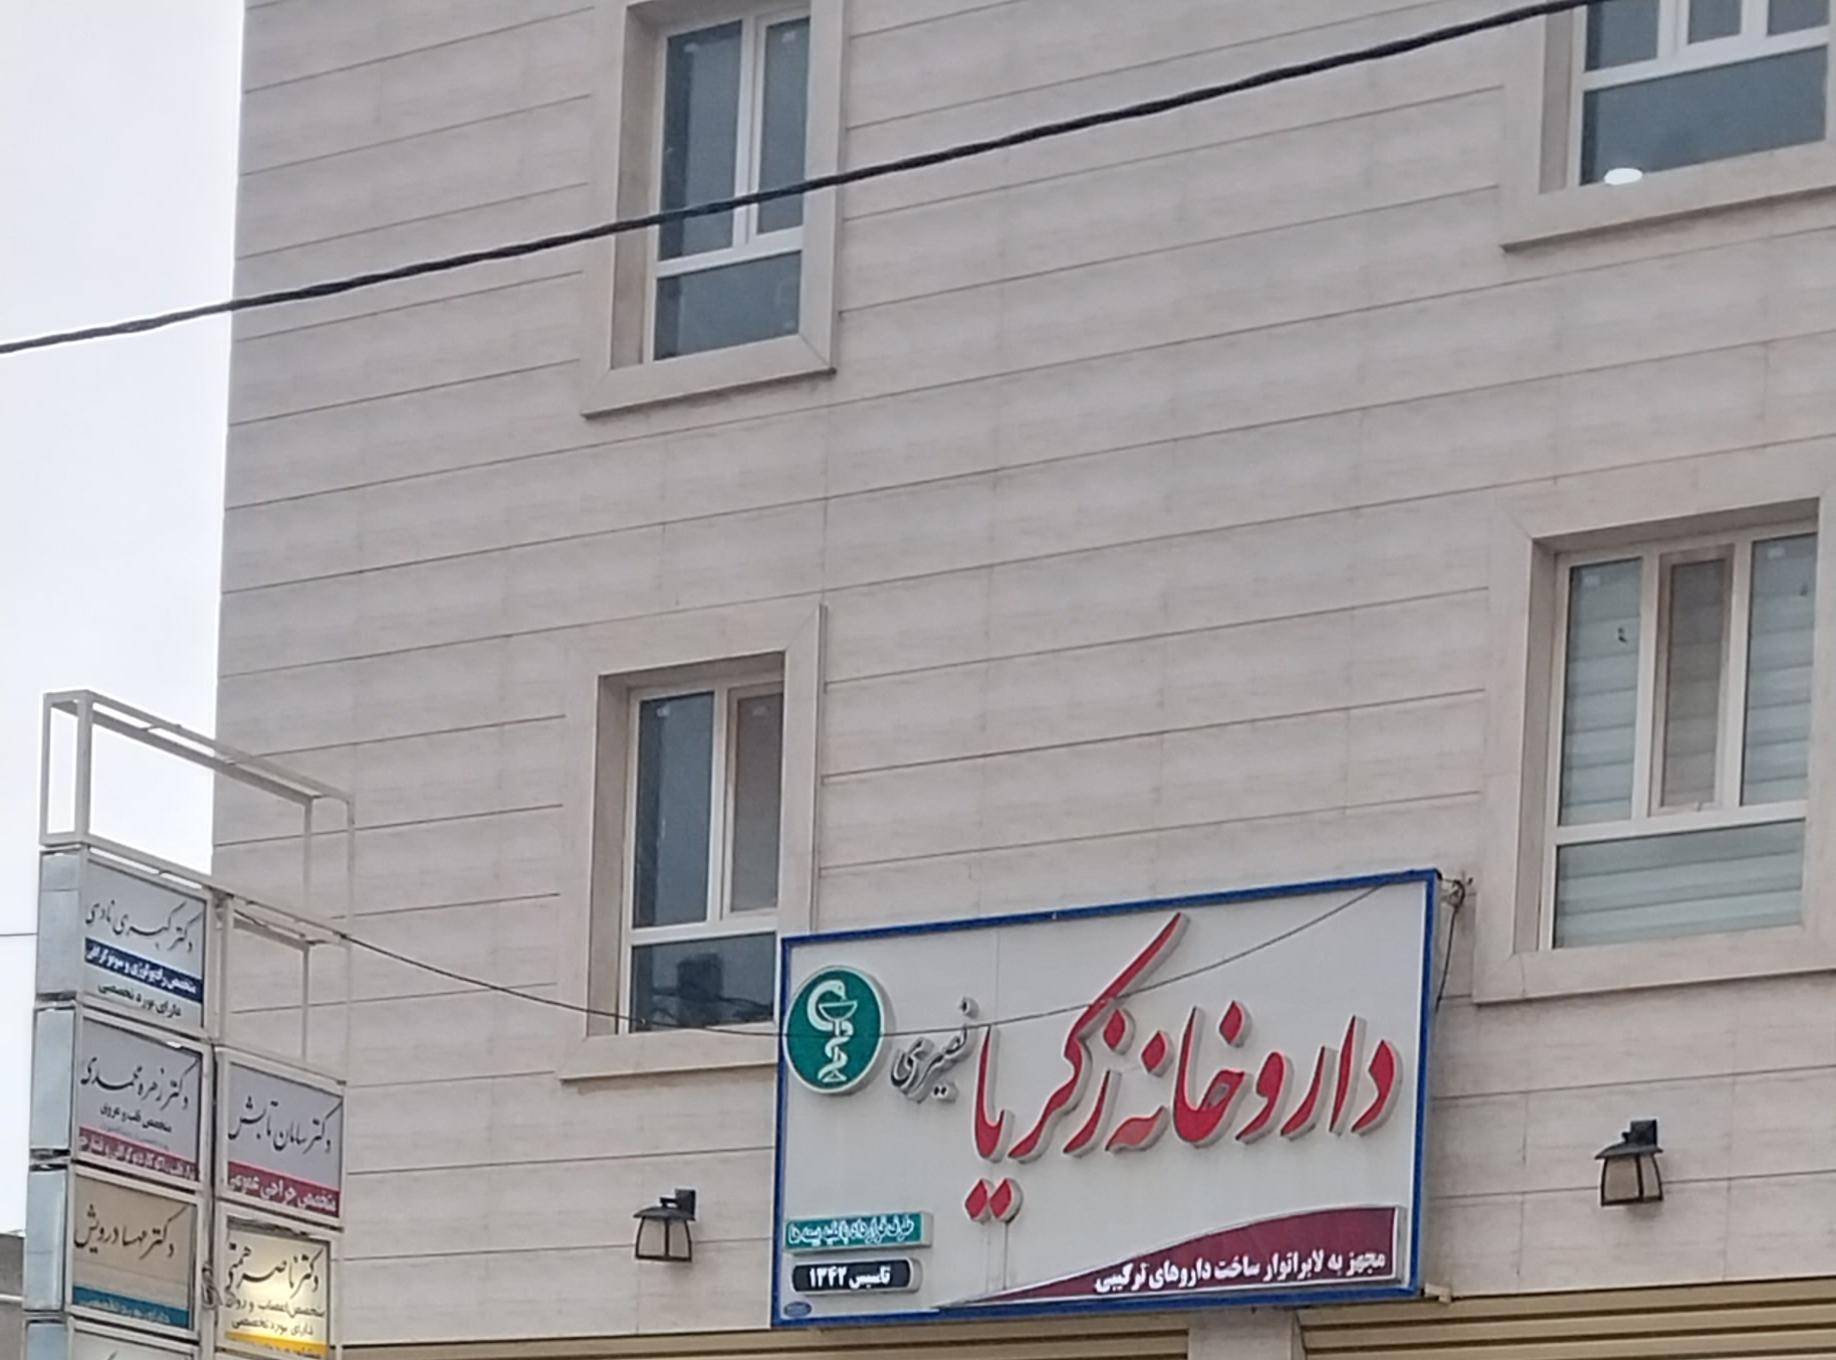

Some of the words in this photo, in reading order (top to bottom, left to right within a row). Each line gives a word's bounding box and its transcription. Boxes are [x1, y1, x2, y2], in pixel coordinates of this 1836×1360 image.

[167, 911, 203, 952] دکتر
[890, 996, 979, 1103] نصیری
[964, 911, 1190, 1223] زکریا
[80, 1056, 143, 1091] محمدی
[159, 1058, 198, 1111] دکتر
[1106, 999, 1399, 1154] داروخانه
[227, 1095, 279, 1140] تابش
[272, 1119, 307, 1151] سامان
[302, 1099, 342, 1154] دکتر
[73, 1203, 120, 1254] درویش
[139, 1203, 191, 1261] دکتر
[289, 1247, 324, 1300] دکتر
[849, 1264, 892, 1289] تاسیس
[1094, 1262, 1149, 1294] ترکیبی
[1149, 1257, 1212, 1289] داروهای
[1213, 1255, 1261, 1279] ساخت
[1263, 1249, 1325, 1282] لابراتوار
[1327, 1253, 1343, 1276] به
[1346, 1250, 1386, 1276] مجهز
